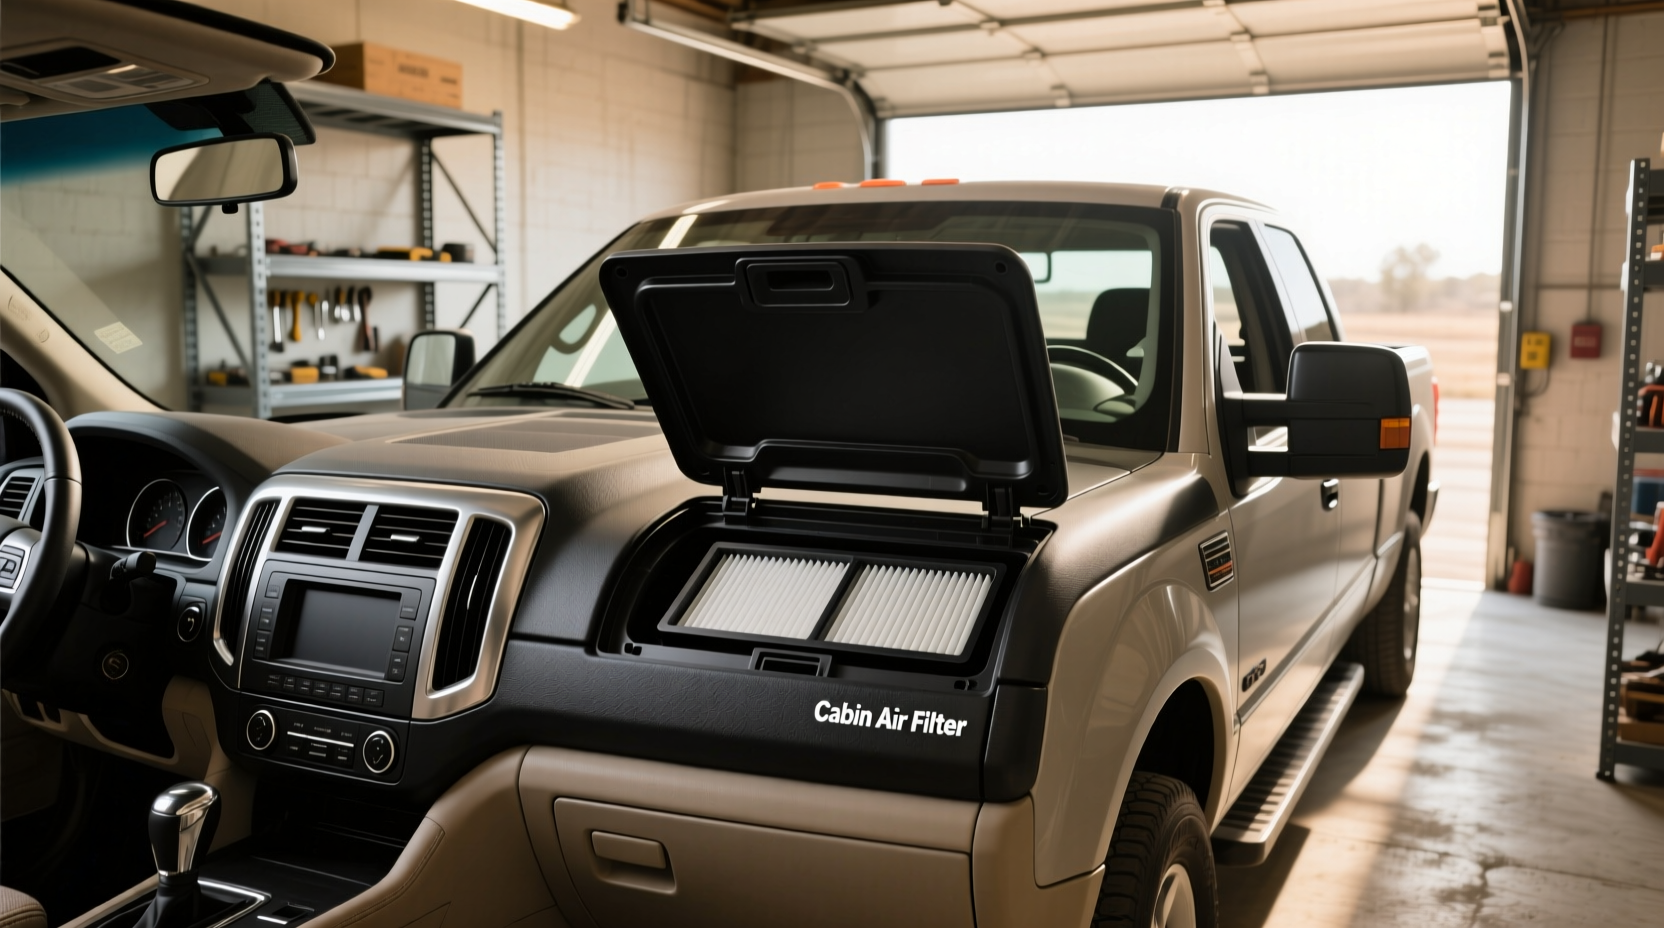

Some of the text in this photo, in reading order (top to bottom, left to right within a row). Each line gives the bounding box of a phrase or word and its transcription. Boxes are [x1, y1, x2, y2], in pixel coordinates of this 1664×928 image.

[814, 700, 968, 737] Cabin Air Filter
